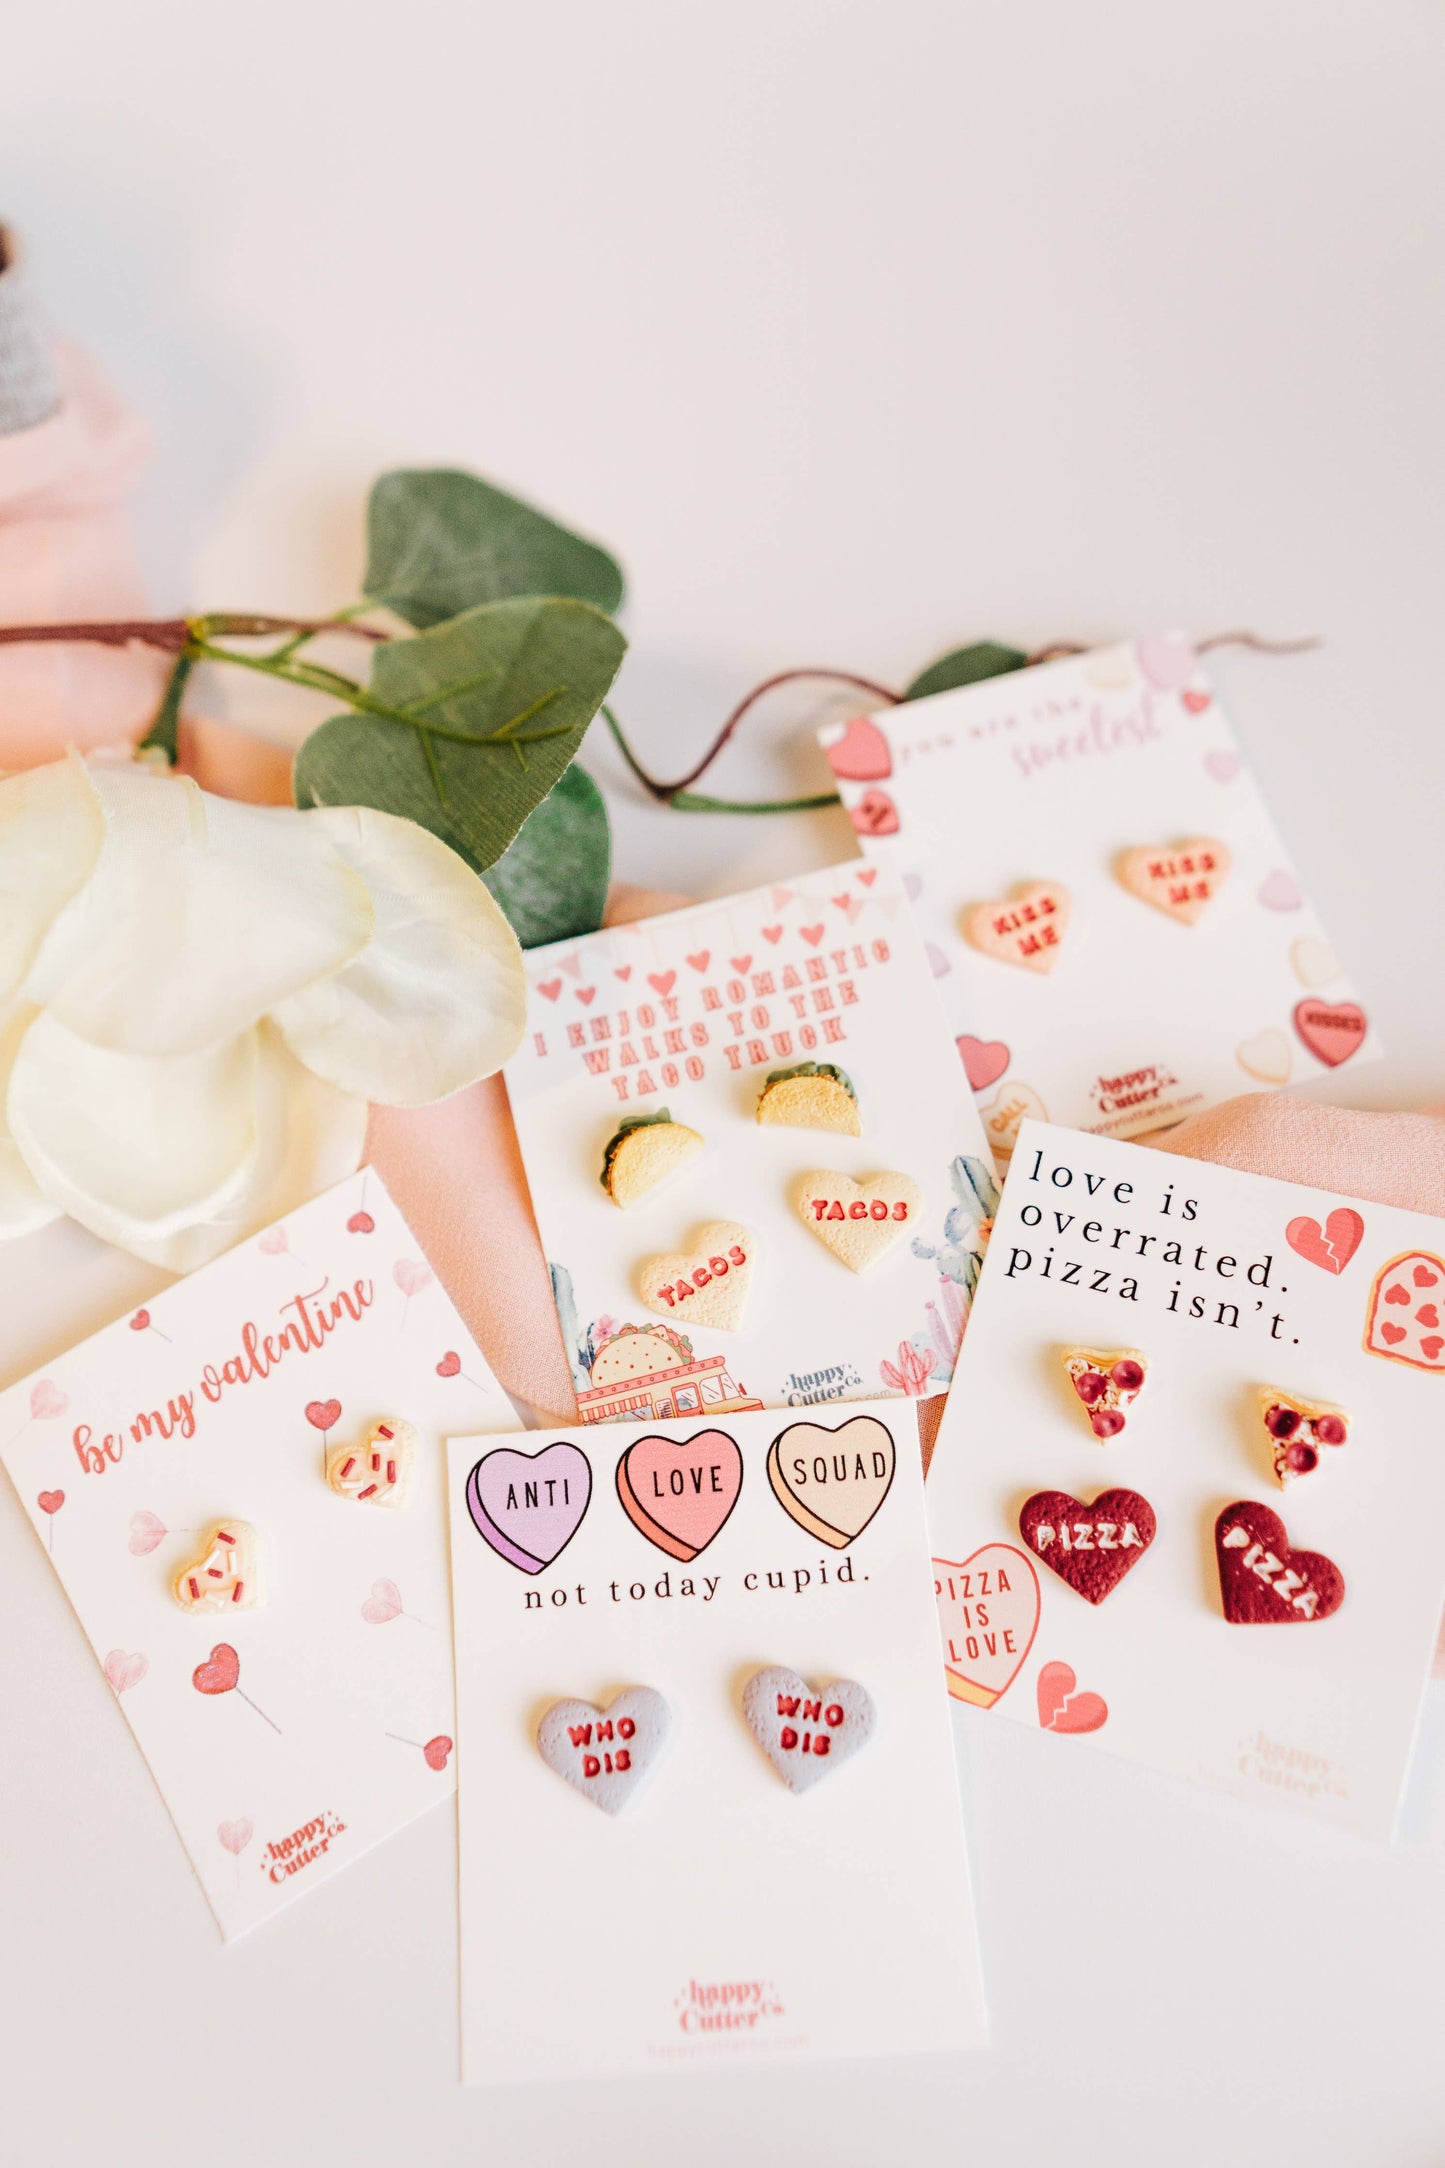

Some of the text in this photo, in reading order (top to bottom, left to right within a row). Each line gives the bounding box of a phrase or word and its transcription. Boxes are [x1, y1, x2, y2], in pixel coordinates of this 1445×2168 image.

[1148, 853, 1215, 880] KISS
[1169, 880, 1210, 905] ME
[992, 898, 1056, 936] KISS
[1017, 925, 1058, 957] ME
[534, 938, 891, 1057] I ENJOY ROMANTIC
[583, 979, 859, 1075] WALKS TO THE
[612, 1015, 847, 1101] TACO TRUCK
[1029, 1150, 1199, 1221] love is
[811, 1199, 908, 1221] TACOS
[1020, 1204, 1289, 1293] overrated.
[656, 1245, 746, 1307] TACOS
[1004, 1247, 1139, 1302] pizza
[73, 1275, 374, 1475] be my valentine
[790, 1364, 845, 1392] happy
[787, 1384, 845, 1407] Cutter
[506, 1452, 886, 1510] ANTI LOVE SQUAD
[1037, 1522, 1144, 1551] PIZZA
[524, 1557, 871, 1609] not today cupid.
[1222, 1525, 1318, 1621] PIZZA
[963, 1603, 990, 1629] IS
[948, 1629, 1017, 1663] LOVE
[777, 1693, 844, 1728] WHO
[567, 1717, 636, 1748] WHO
[780, 1726, 831, 1757] DIS
[582, 1749, 632, 1779] DIS
[266, 1812, 325, 1860] happy
[269, 1838, 329, 1884] Cutter
[690, 1979, 764, 2010] happy
[680, 2010, 759, 2036] Cutter
